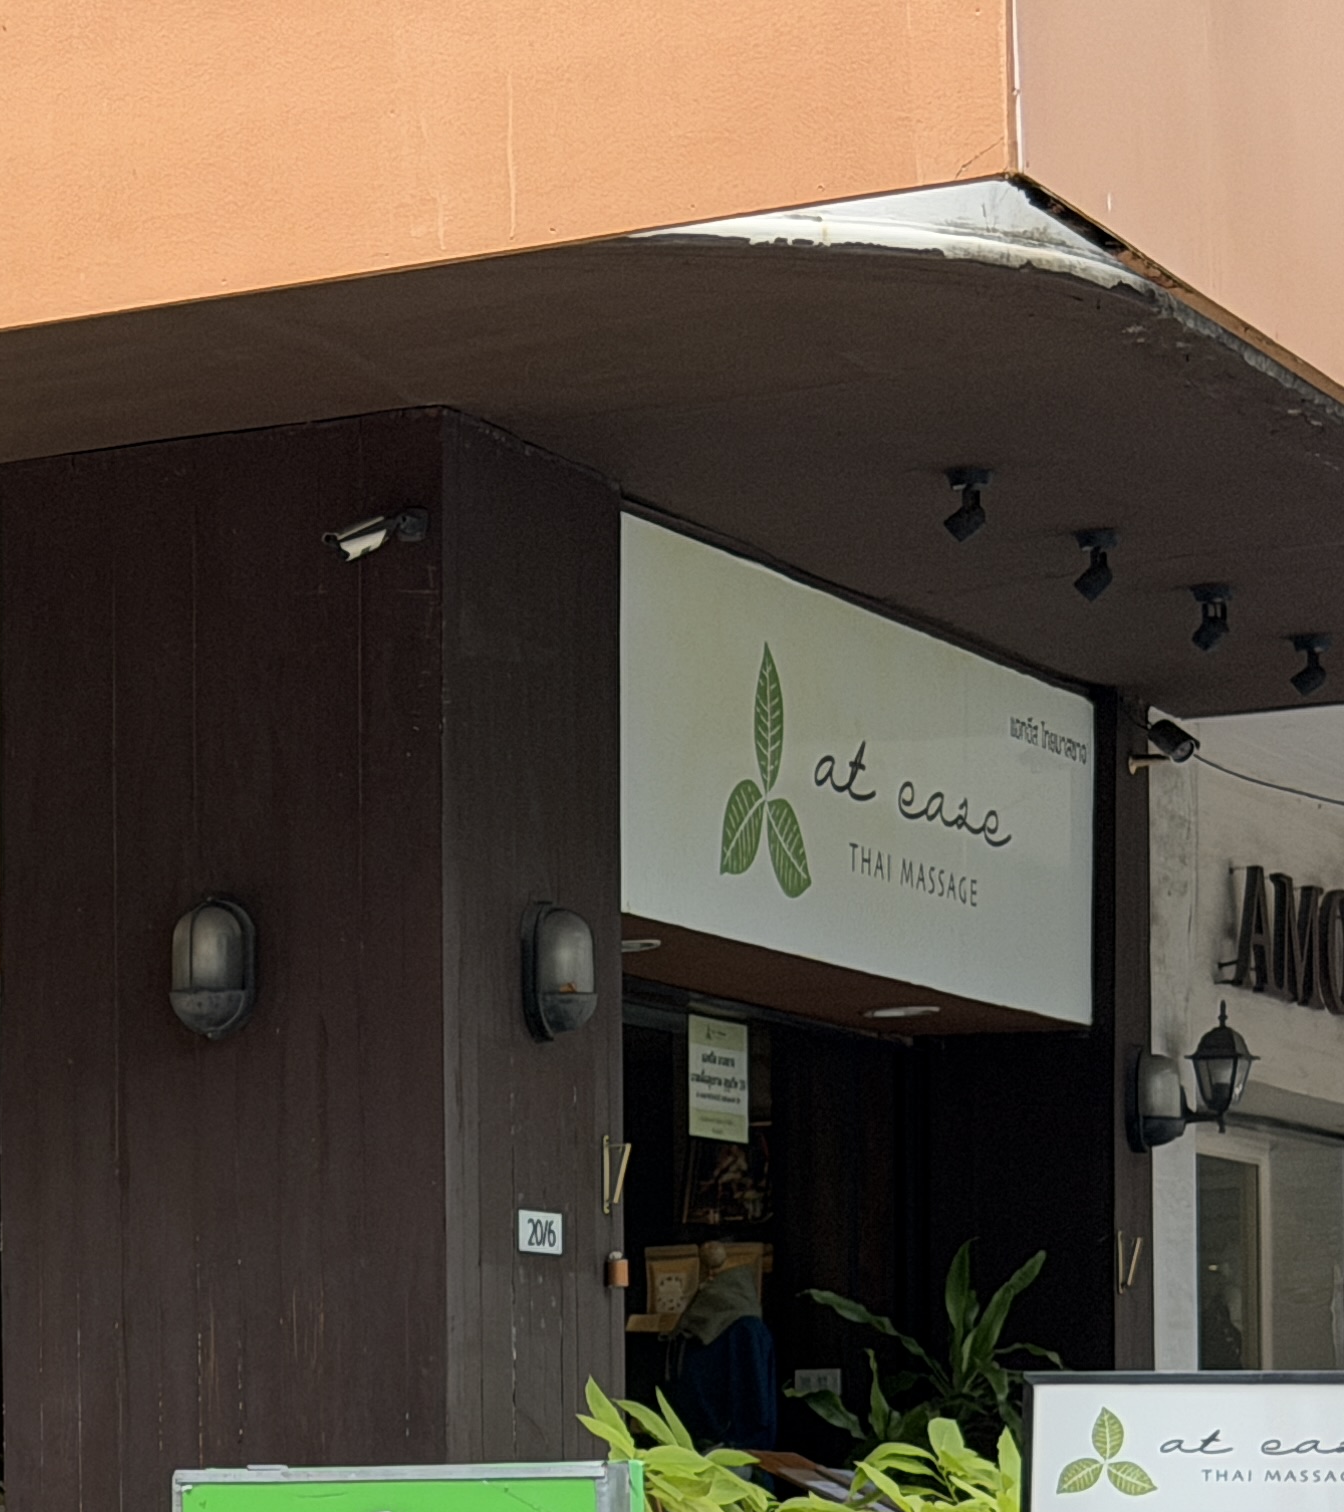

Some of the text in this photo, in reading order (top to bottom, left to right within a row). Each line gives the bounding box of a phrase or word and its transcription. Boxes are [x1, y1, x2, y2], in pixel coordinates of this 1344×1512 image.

[813, 740, 1012, 848] at ease
[848, 842, 980, 908] THAI MASSAGE
[527, 1218, 557, 1247] 20/6
[1159, 1429, 1344, 1456] at ea
[1202, 1469, 1252, 1483] THAI
